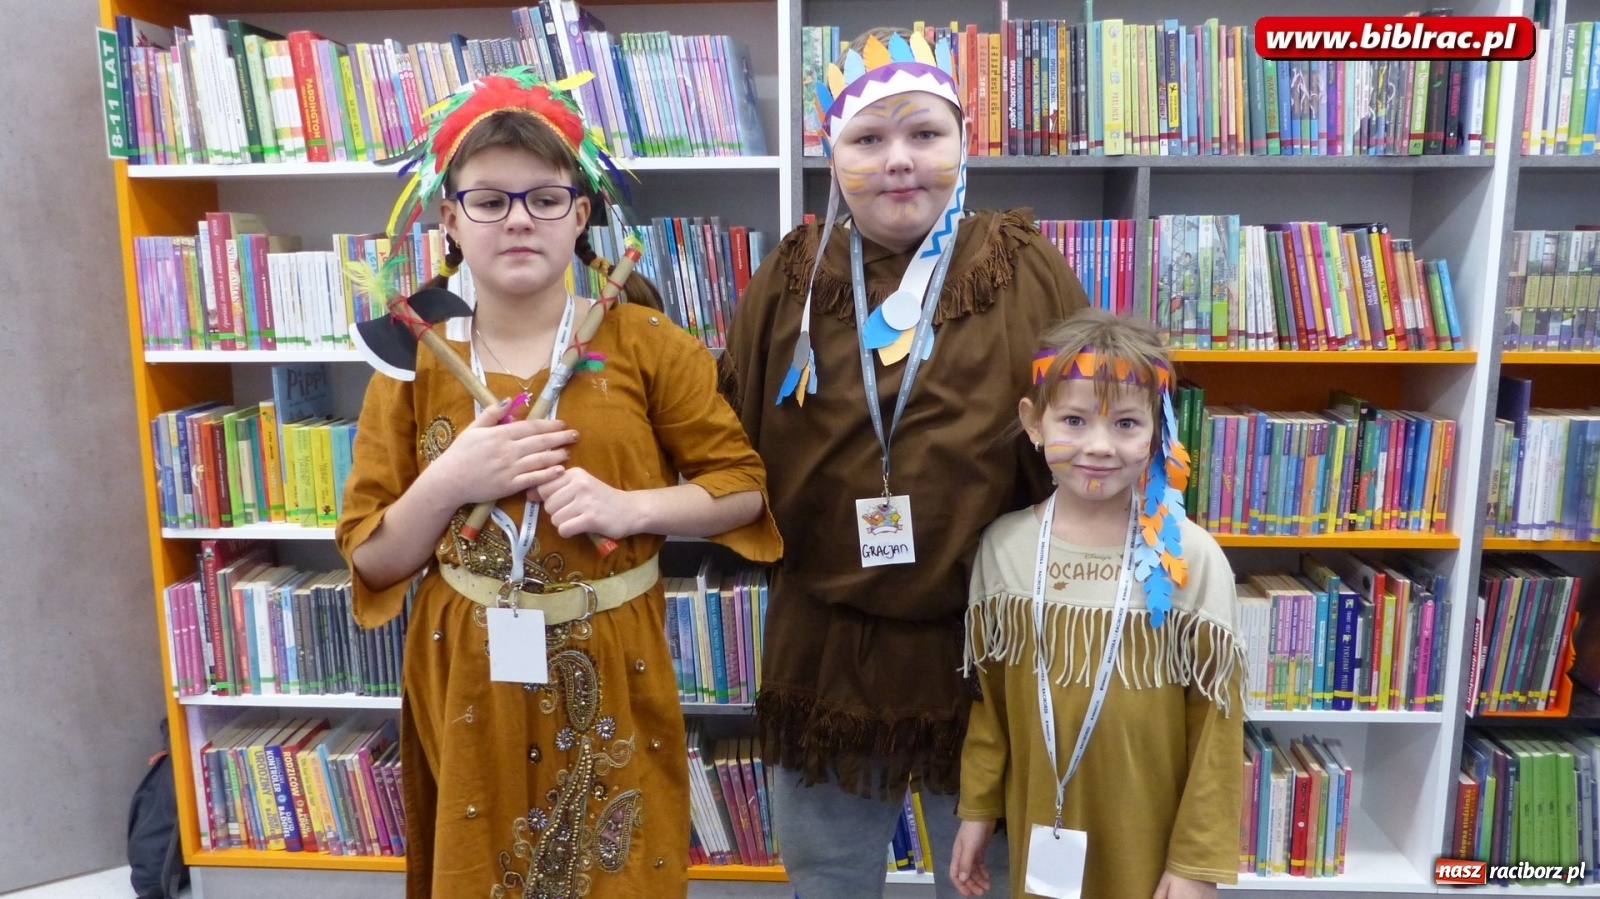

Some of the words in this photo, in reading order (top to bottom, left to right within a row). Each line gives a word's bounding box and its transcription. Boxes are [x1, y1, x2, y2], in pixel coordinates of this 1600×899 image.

[102, 39, 118, 90] LAT
[107, 99, 123, 148] 8-11
[305, 78, 321, 138] PADDINGTON
[230, 269, 240, 303] GAIMAN
[1491, 470, 1499, 495] SMUGA
[207, 563, 215, 585] WIELKA
[1046, 562, 1123, 581] OCAHO
[209, 586, 219, 631] ENCYKLOPEDIA
[213, 631, 224, 680] KRASNOLUDKÓW
[1107, 639, 1117, 664] BIBLIOTEKA
[1466, 654, 1477, 704] dorosłych
[254, 750, 272, 796] URODZINY
[265, 750, 281, 792] KONTROLER
[283, 751, 300, 797] RODZICÓW
[278, 806, 291, 838] BADDIEL
[285, 811, 295, 832] DAVID
[296, 808, 309, 839] BADDIEL
[1462, 789, 1472, 829] studzienka
[1459, 829, 1468, 859] udowna
